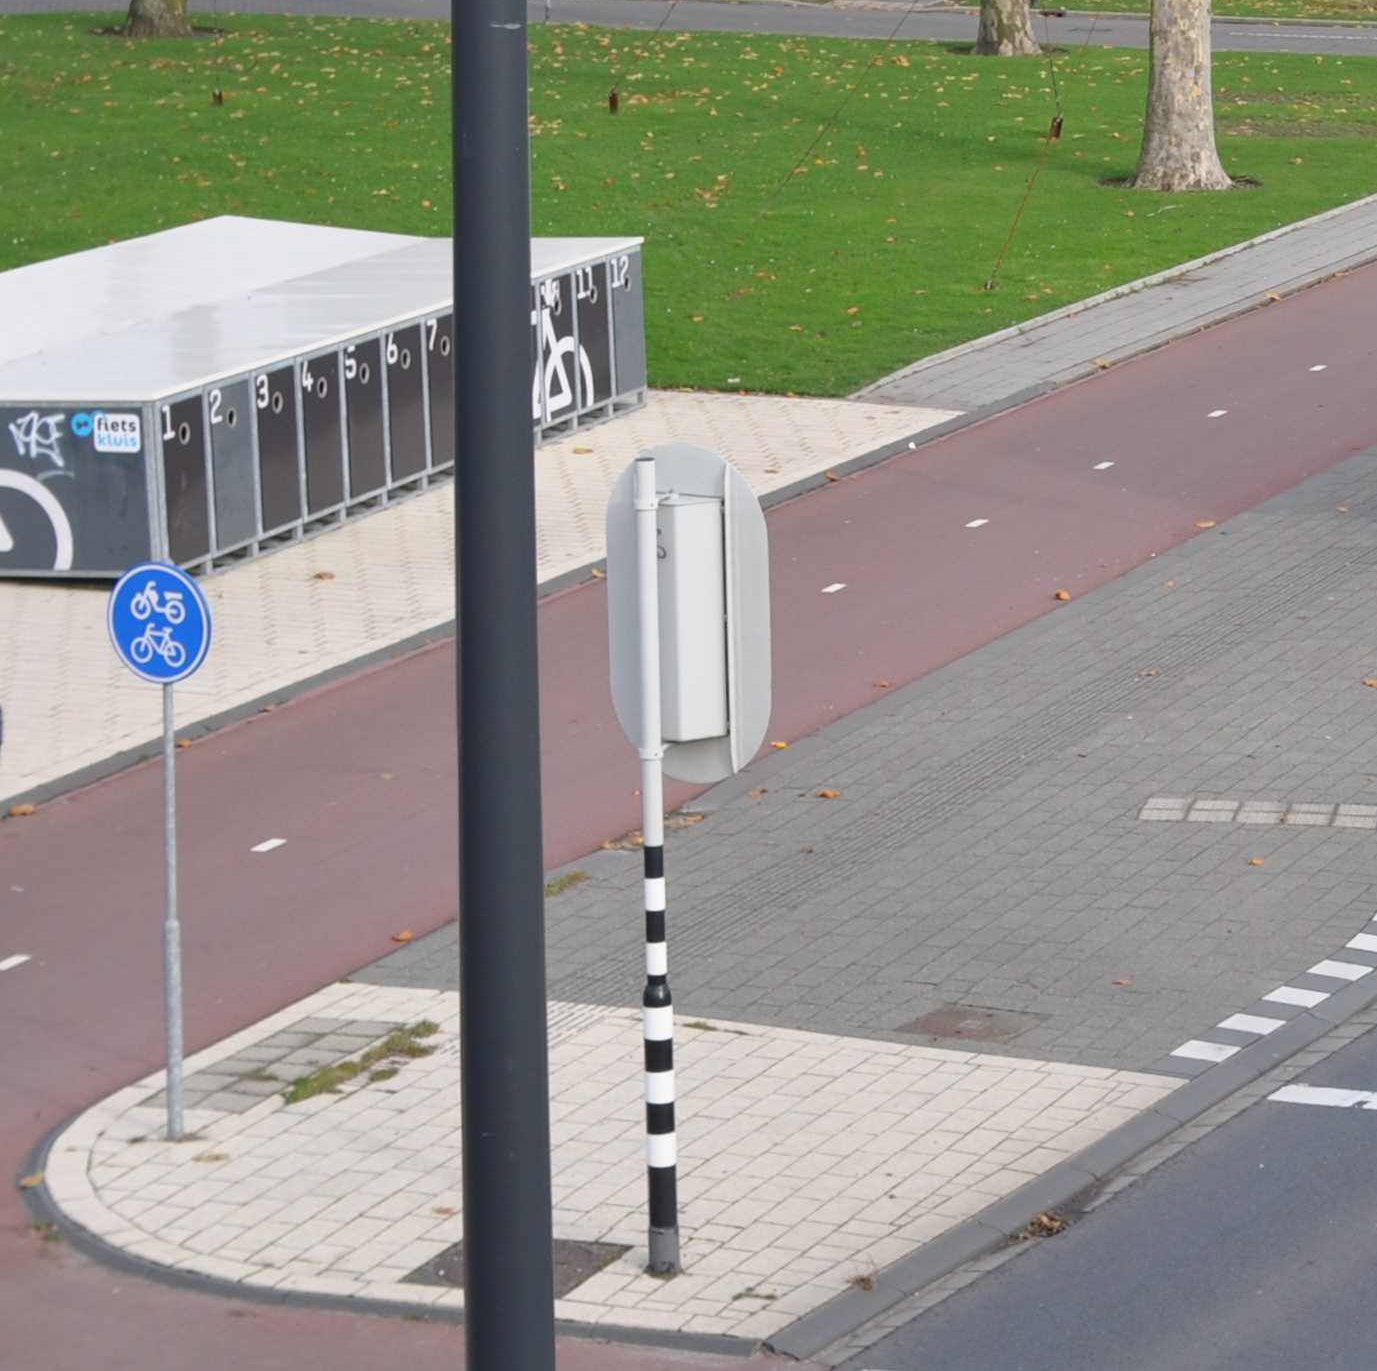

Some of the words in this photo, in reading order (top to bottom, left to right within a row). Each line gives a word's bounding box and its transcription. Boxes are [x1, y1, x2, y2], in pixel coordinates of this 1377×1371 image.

[577, 266, 593, 300] 11
[611, 255, 629, 288] 12
[386, 332, 399, 364] 6
[426, 319, 438, 351] 7
[301, 361, 314, 392] 4
[344, 345, 357, 379] 5
[209, 389, 223, 425] 2
[256, 374, 269, 409] 3
[97, 417, 137, 432] fiets
[161, 404, 175, 441] 1
[98, 434, 137, 447] kluis
